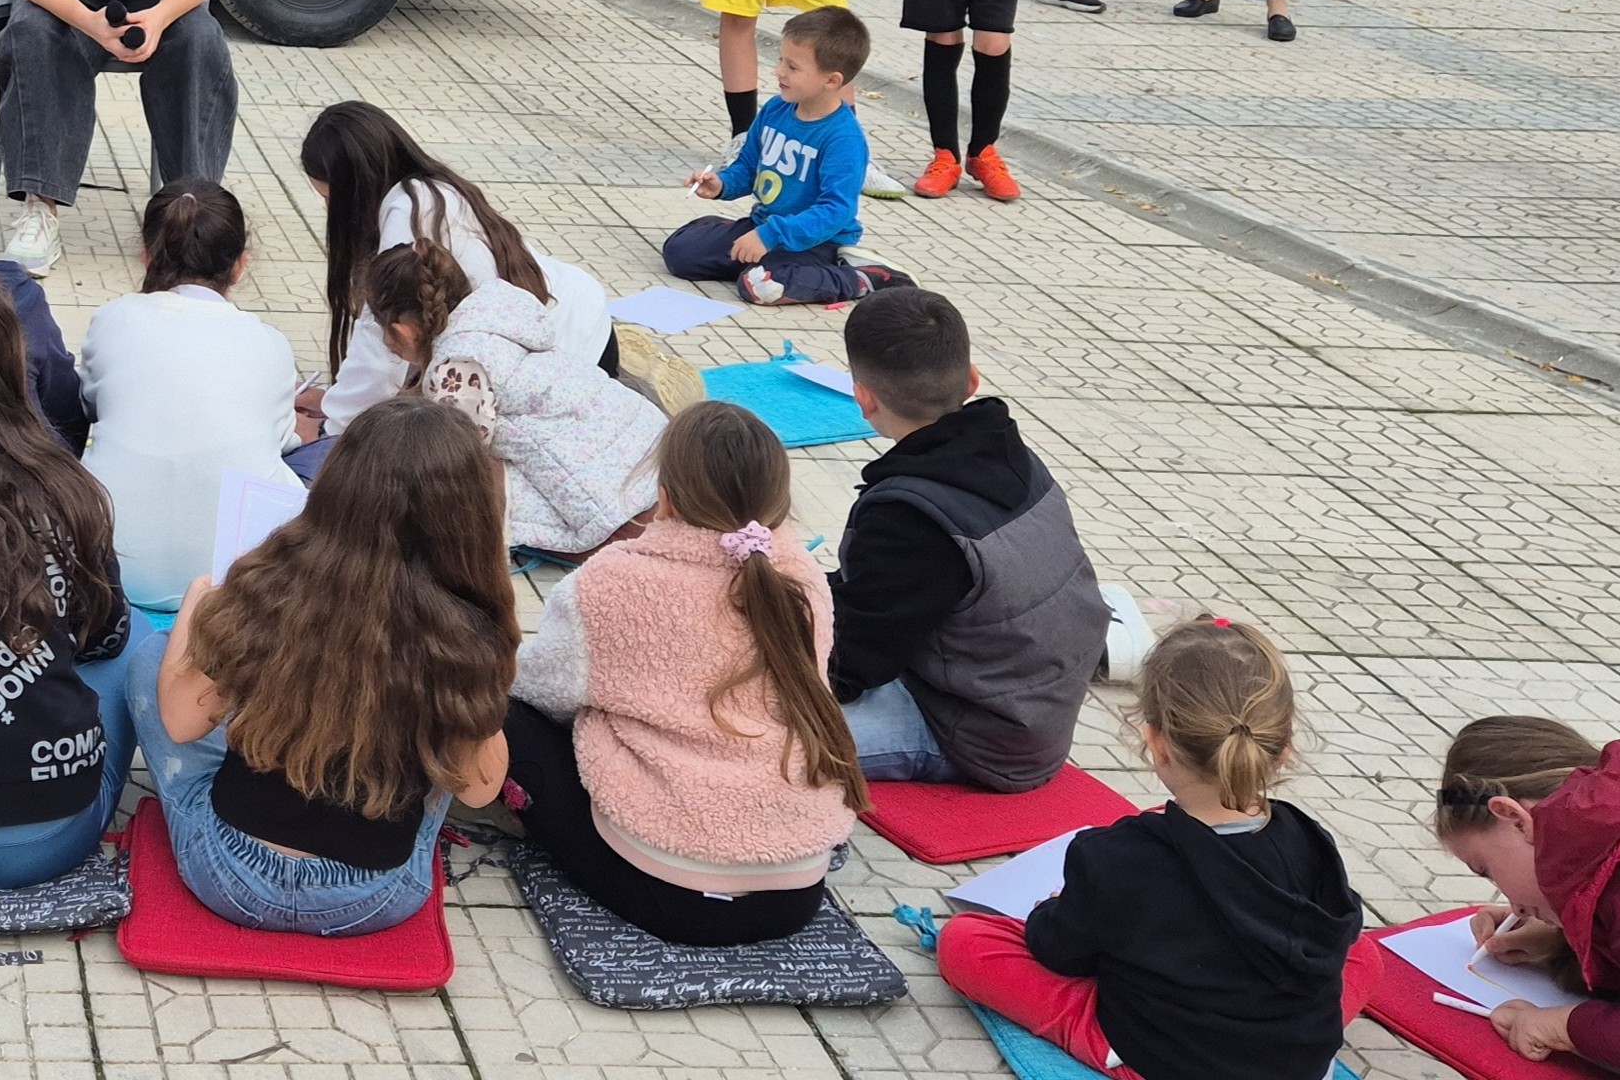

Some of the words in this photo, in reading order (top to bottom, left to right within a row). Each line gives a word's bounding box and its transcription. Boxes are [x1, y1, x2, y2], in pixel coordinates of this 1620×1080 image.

[15, 913, 41, 924] Enjoy
[789, 942, 847, 951] Holiday
[779, 962, 850, 971] Holiday
